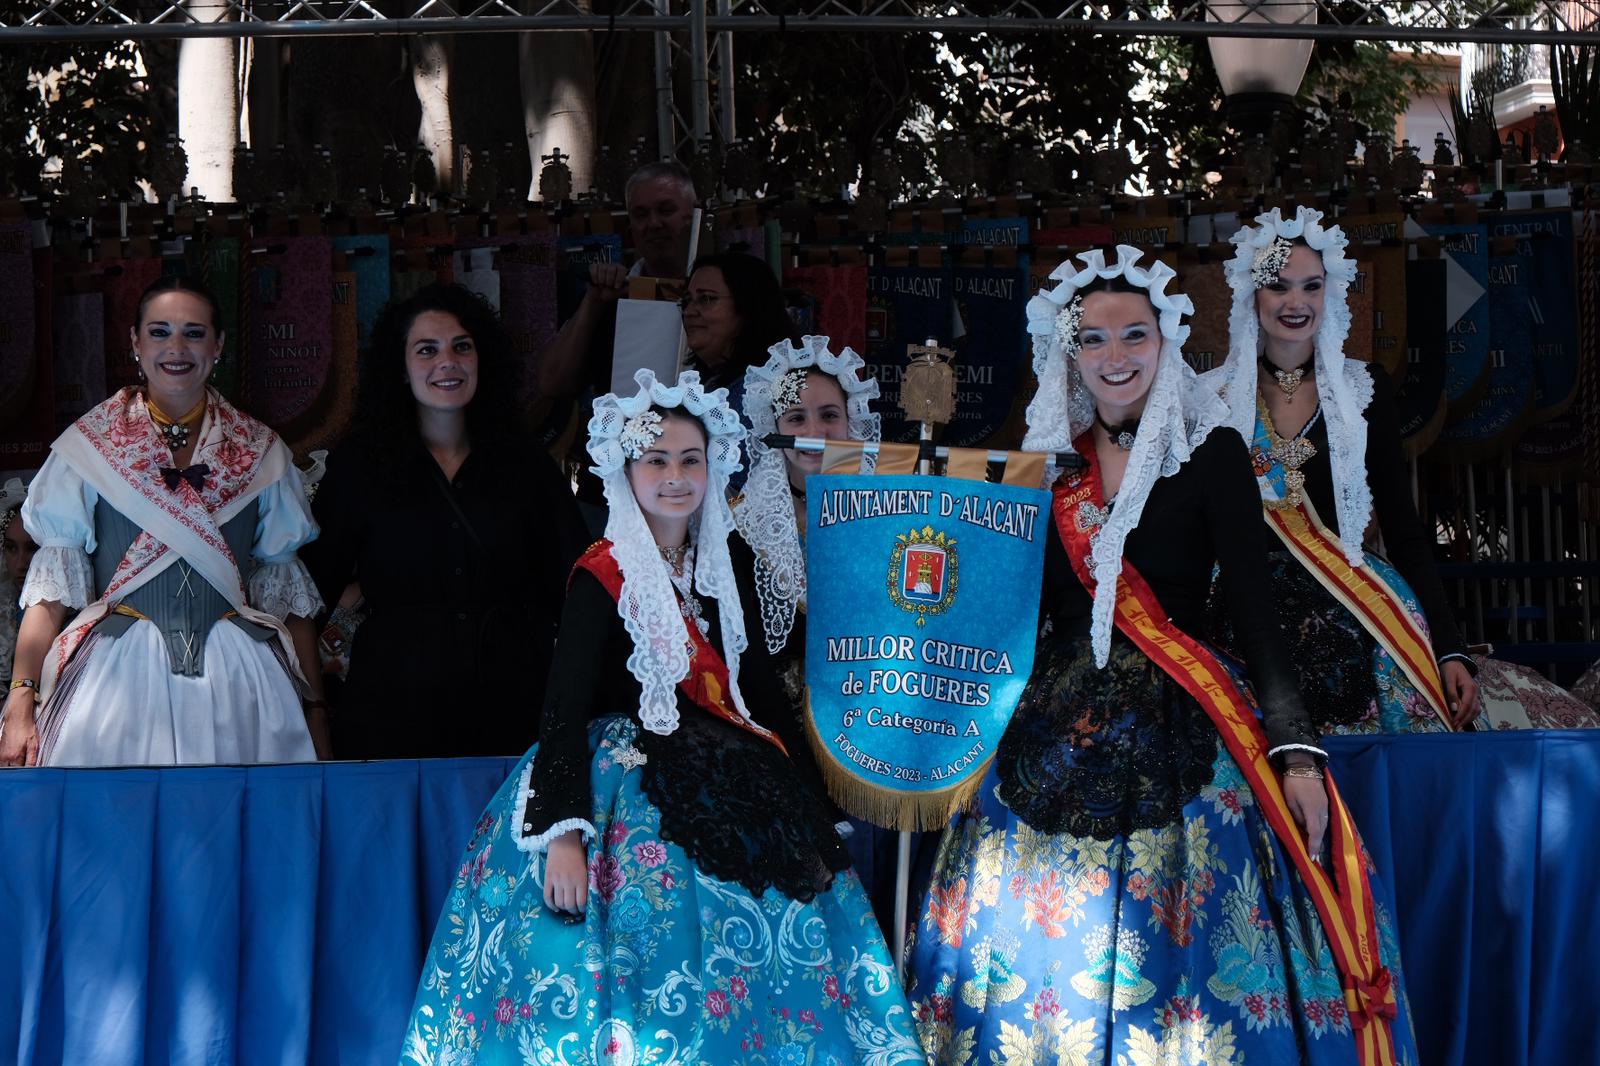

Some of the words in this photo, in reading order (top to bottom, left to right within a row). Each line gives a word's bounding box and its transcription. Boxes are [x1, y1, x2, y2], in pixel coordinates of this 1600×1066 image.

[819, 490, 932, 526] AJUNTAMENT
[1063, 488, 1091, 509] 2023
[827, 635, 915, 662] MILLOR
[920, 639, 1013, 674] CRITICA
[841, 672, 863, 695] de
[868, 670, 991, 706] FOGUERES
[842, 707, 861, 728] 6ª
[866, 708, 957, 737] Categoría
[963, 720, 980, 737] A
[833, 733, 891, 776] FOGUERES
[894, 766, 921, 783] 2023
[930, 740, 986, 782] ALACANT
